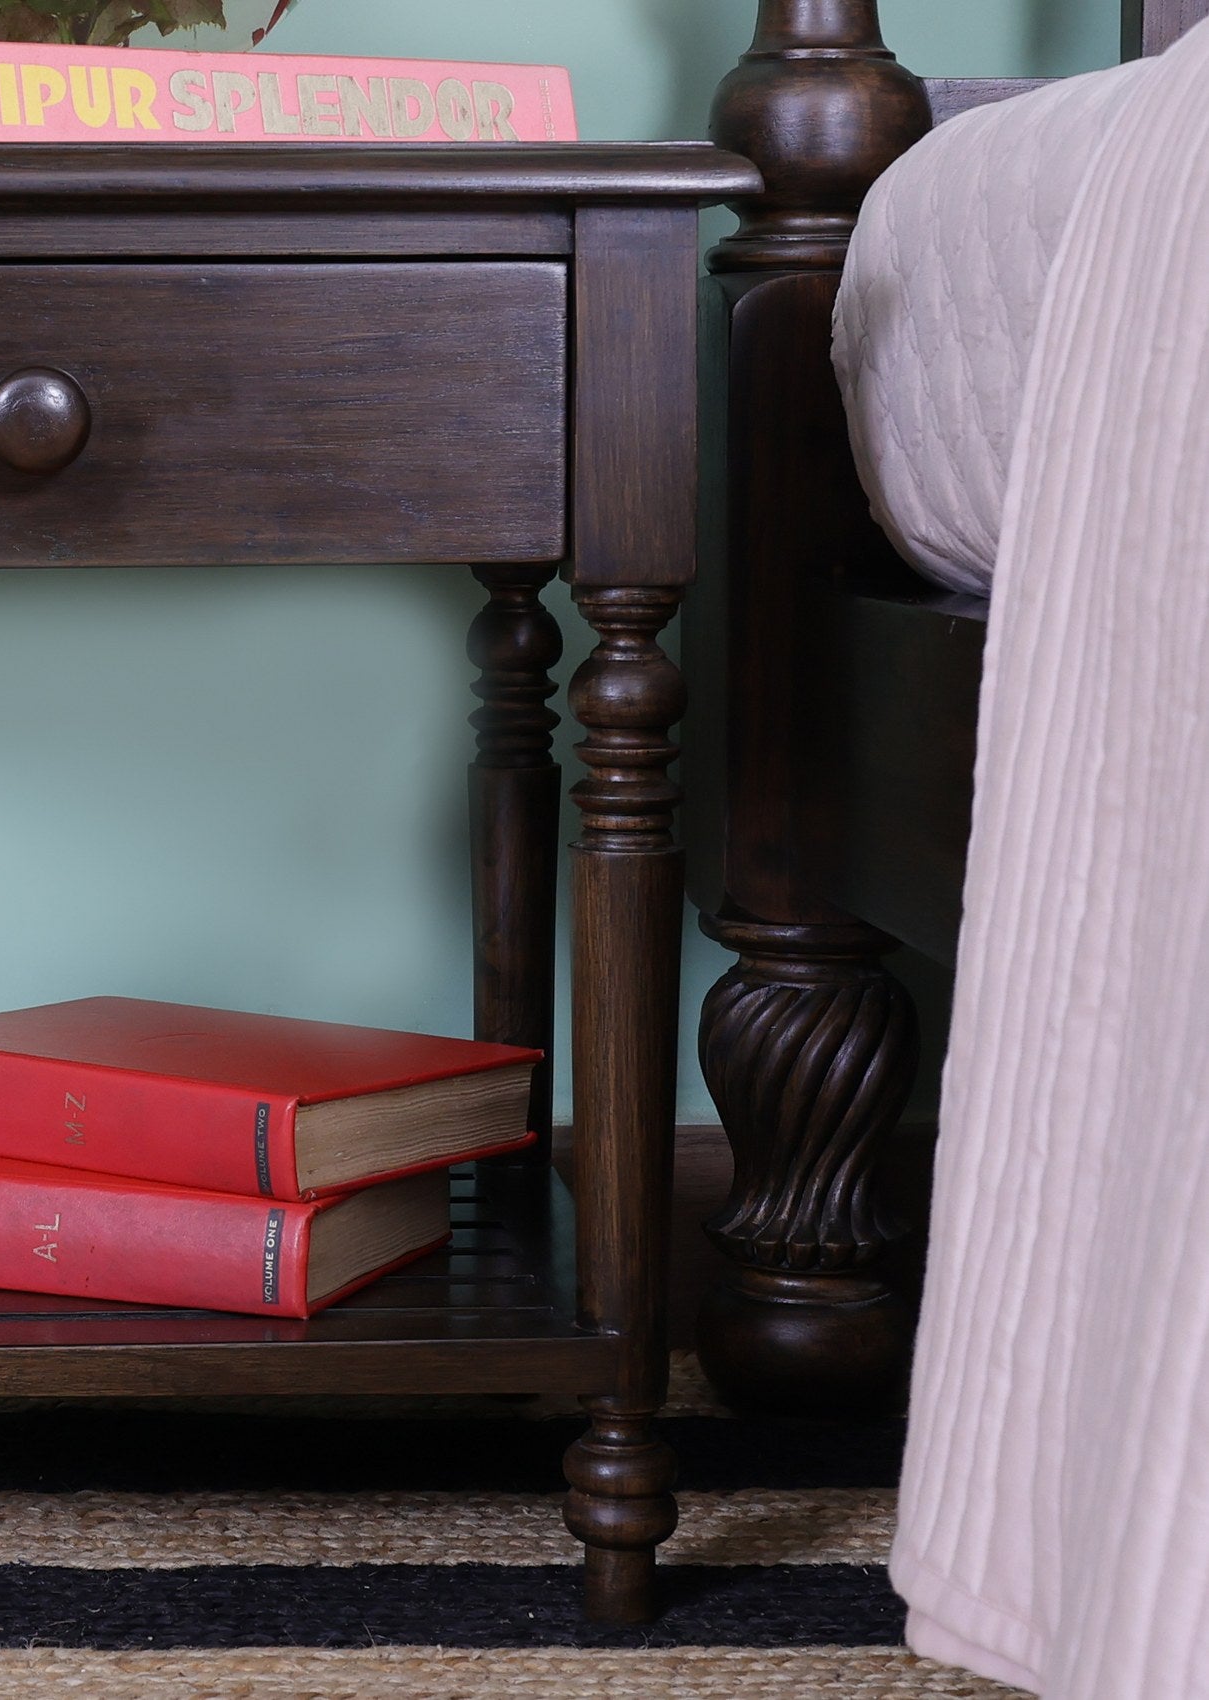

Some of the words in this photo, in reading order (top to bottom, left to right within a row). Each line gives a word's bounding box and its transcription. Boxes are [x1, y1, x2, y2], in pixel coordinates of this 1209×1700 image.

[169, 70, 521, 141] SPLENDOR
[64, 1091, 86, 1146] M-Z
[257, 1108, 266, 1135] TWO
[32, 1213, 61, 1263] A-L
[267, 1219, 278, 1248] ONE
[264, 1252, 274, 1303] VOLUME
